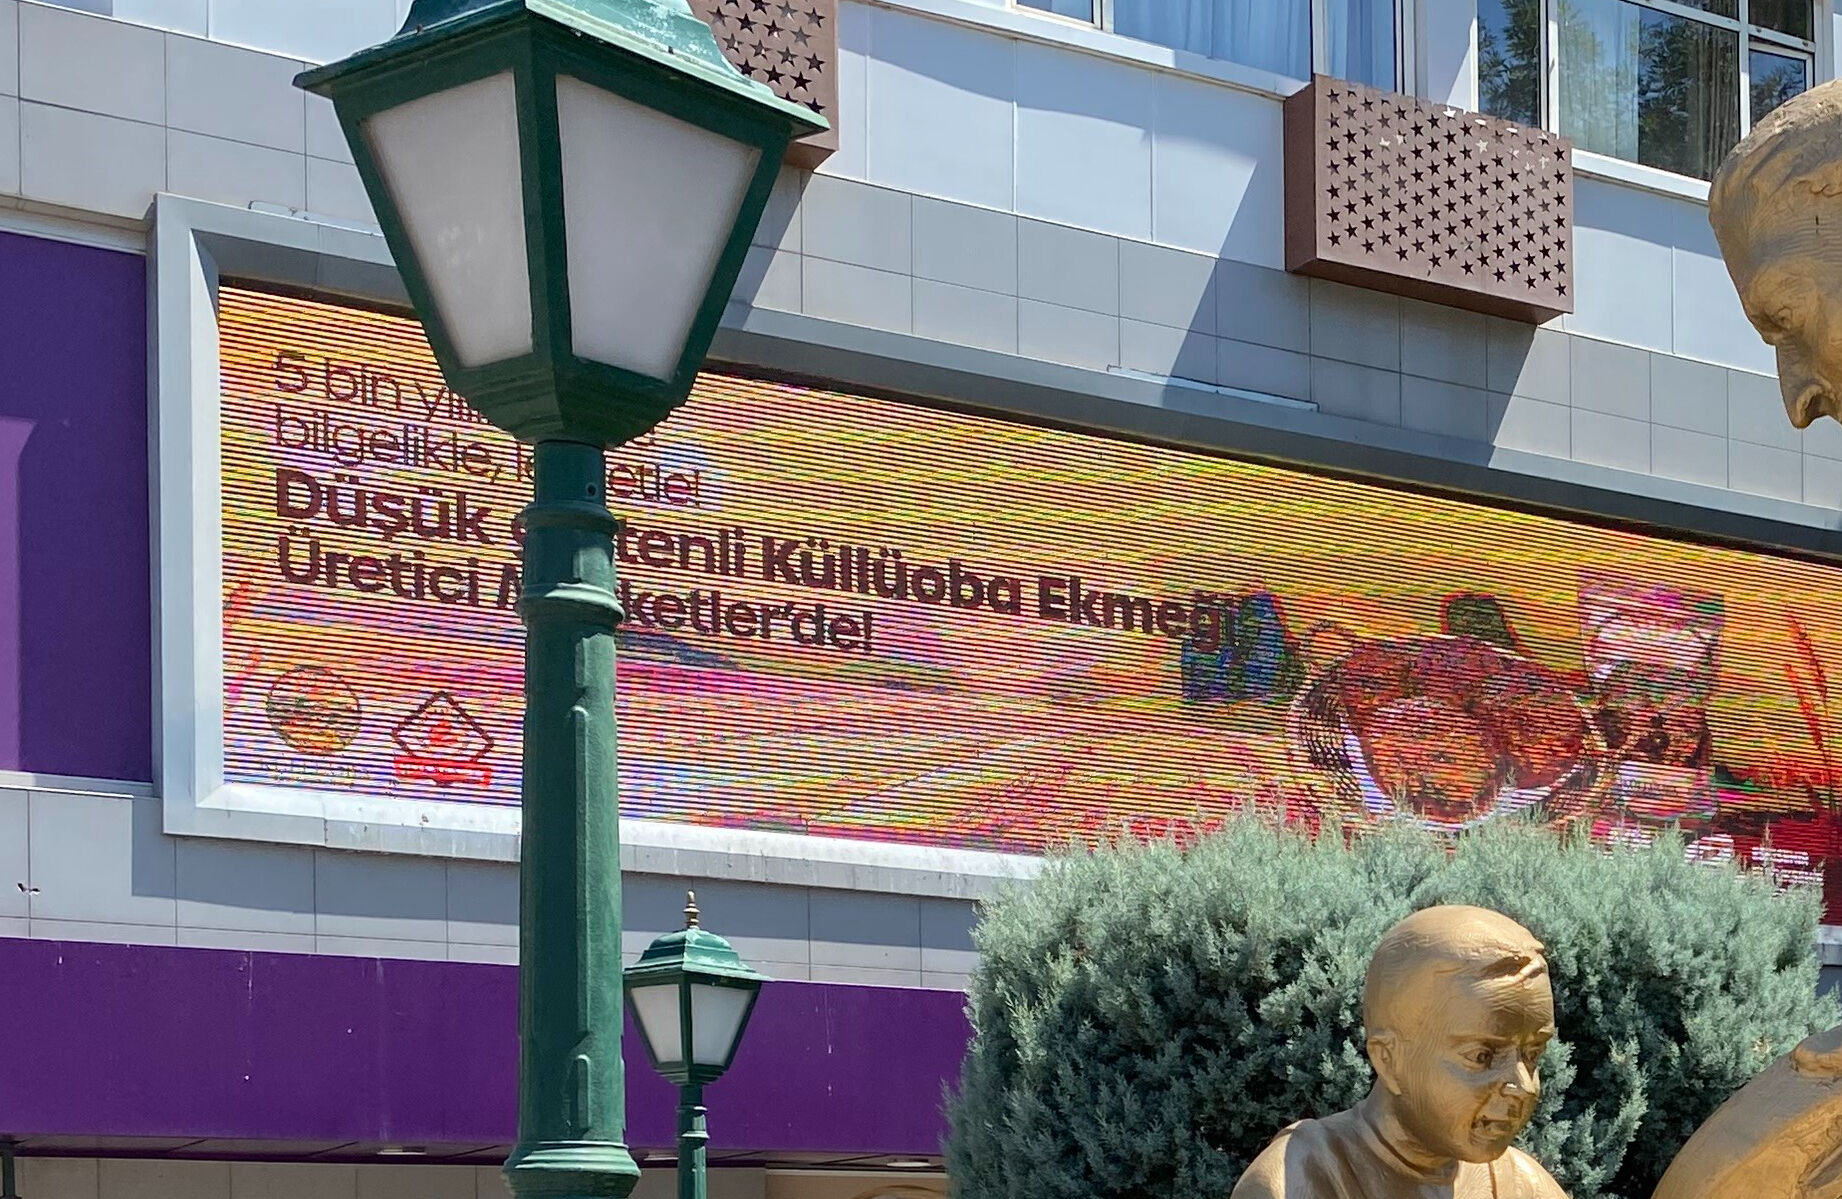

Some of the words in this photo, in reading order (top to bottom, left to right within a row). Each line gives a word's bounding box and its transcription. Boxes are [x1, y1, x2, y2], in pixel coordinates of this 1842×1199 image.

[272, 350, 307, 392] 5
[324, 357, 402, 410] bin
[275, 403, 502, 485] bilgelikle,
[275, 467, 496, 544] Düşük
[761, 534, 1022, 616] Küllüoba
[277, 524, 480, 606] Üretici
